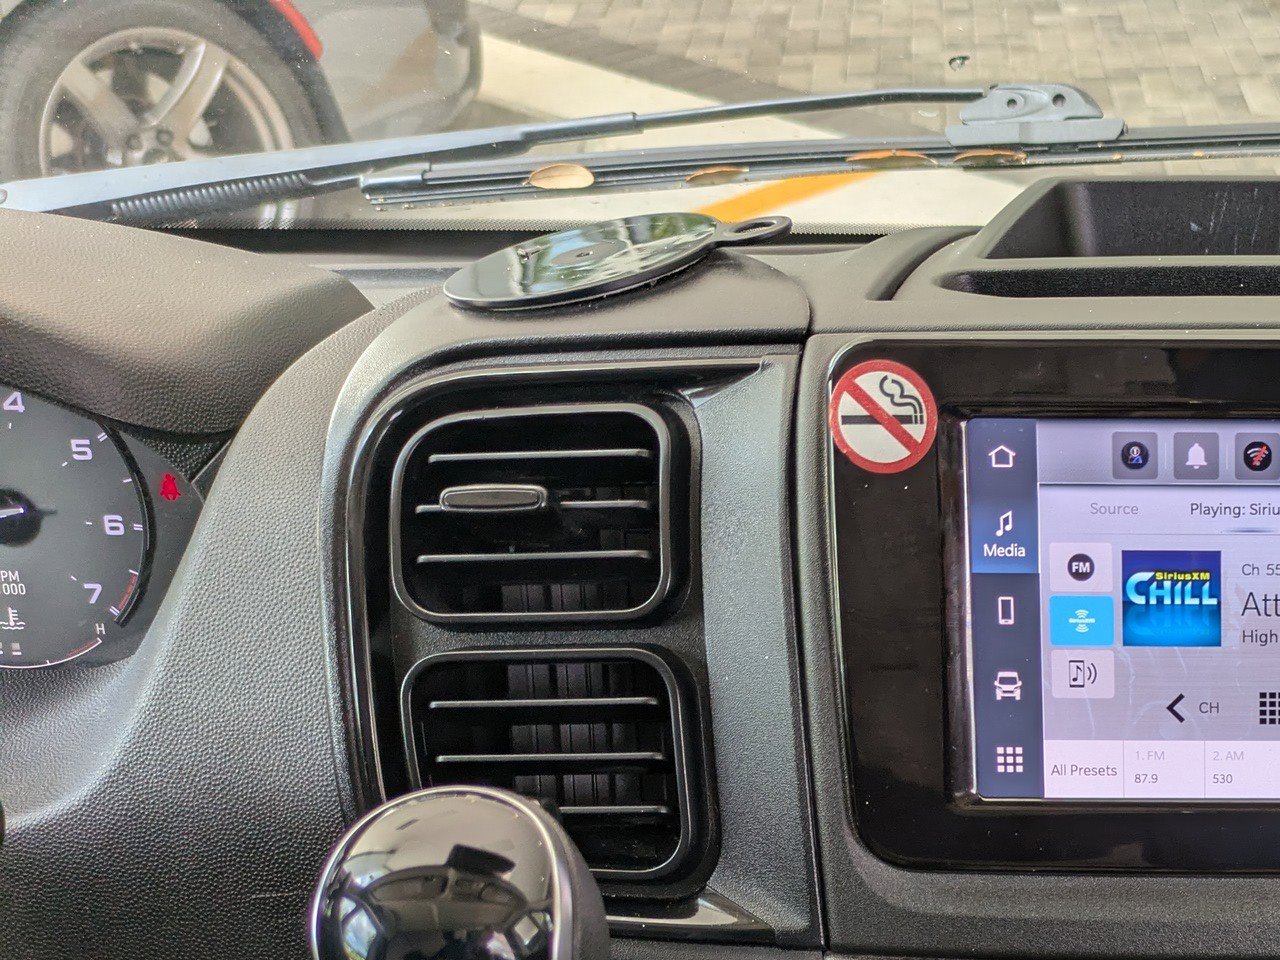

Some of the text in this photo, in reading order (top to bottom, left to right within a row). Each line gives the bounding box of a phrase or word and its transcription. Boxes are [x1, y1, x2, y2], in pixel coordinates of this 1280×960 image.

[2, 391, 25, 413] 4
[70, 439, 93, 461] 5
[1089, 502, 1139, 516] Source
[1190, 502, 1246, 519] Playing:
[102, 514, 125, 536] 6
[983, 543, 1026, 558] Media
[1071, 562, 1091, 573] FM
[1241, 563, 1260, 576] Ch
[1154, 571, 1211, 581] SiriusXM
[83, 582, 103, 604] 7
[1125, 571, 1218, 605] CHILL
[95, 623, 106, 636] H
[1199, 702, 1220, 715] CH
[1147, 750, 1165, 761] FM
[1225, 751, 1245, 761] AM
[1050, 764, 1118, 777] All Presets
[1134, 773, 1159, 784] 87.9
[1212, 774, 1233, 784] 530
